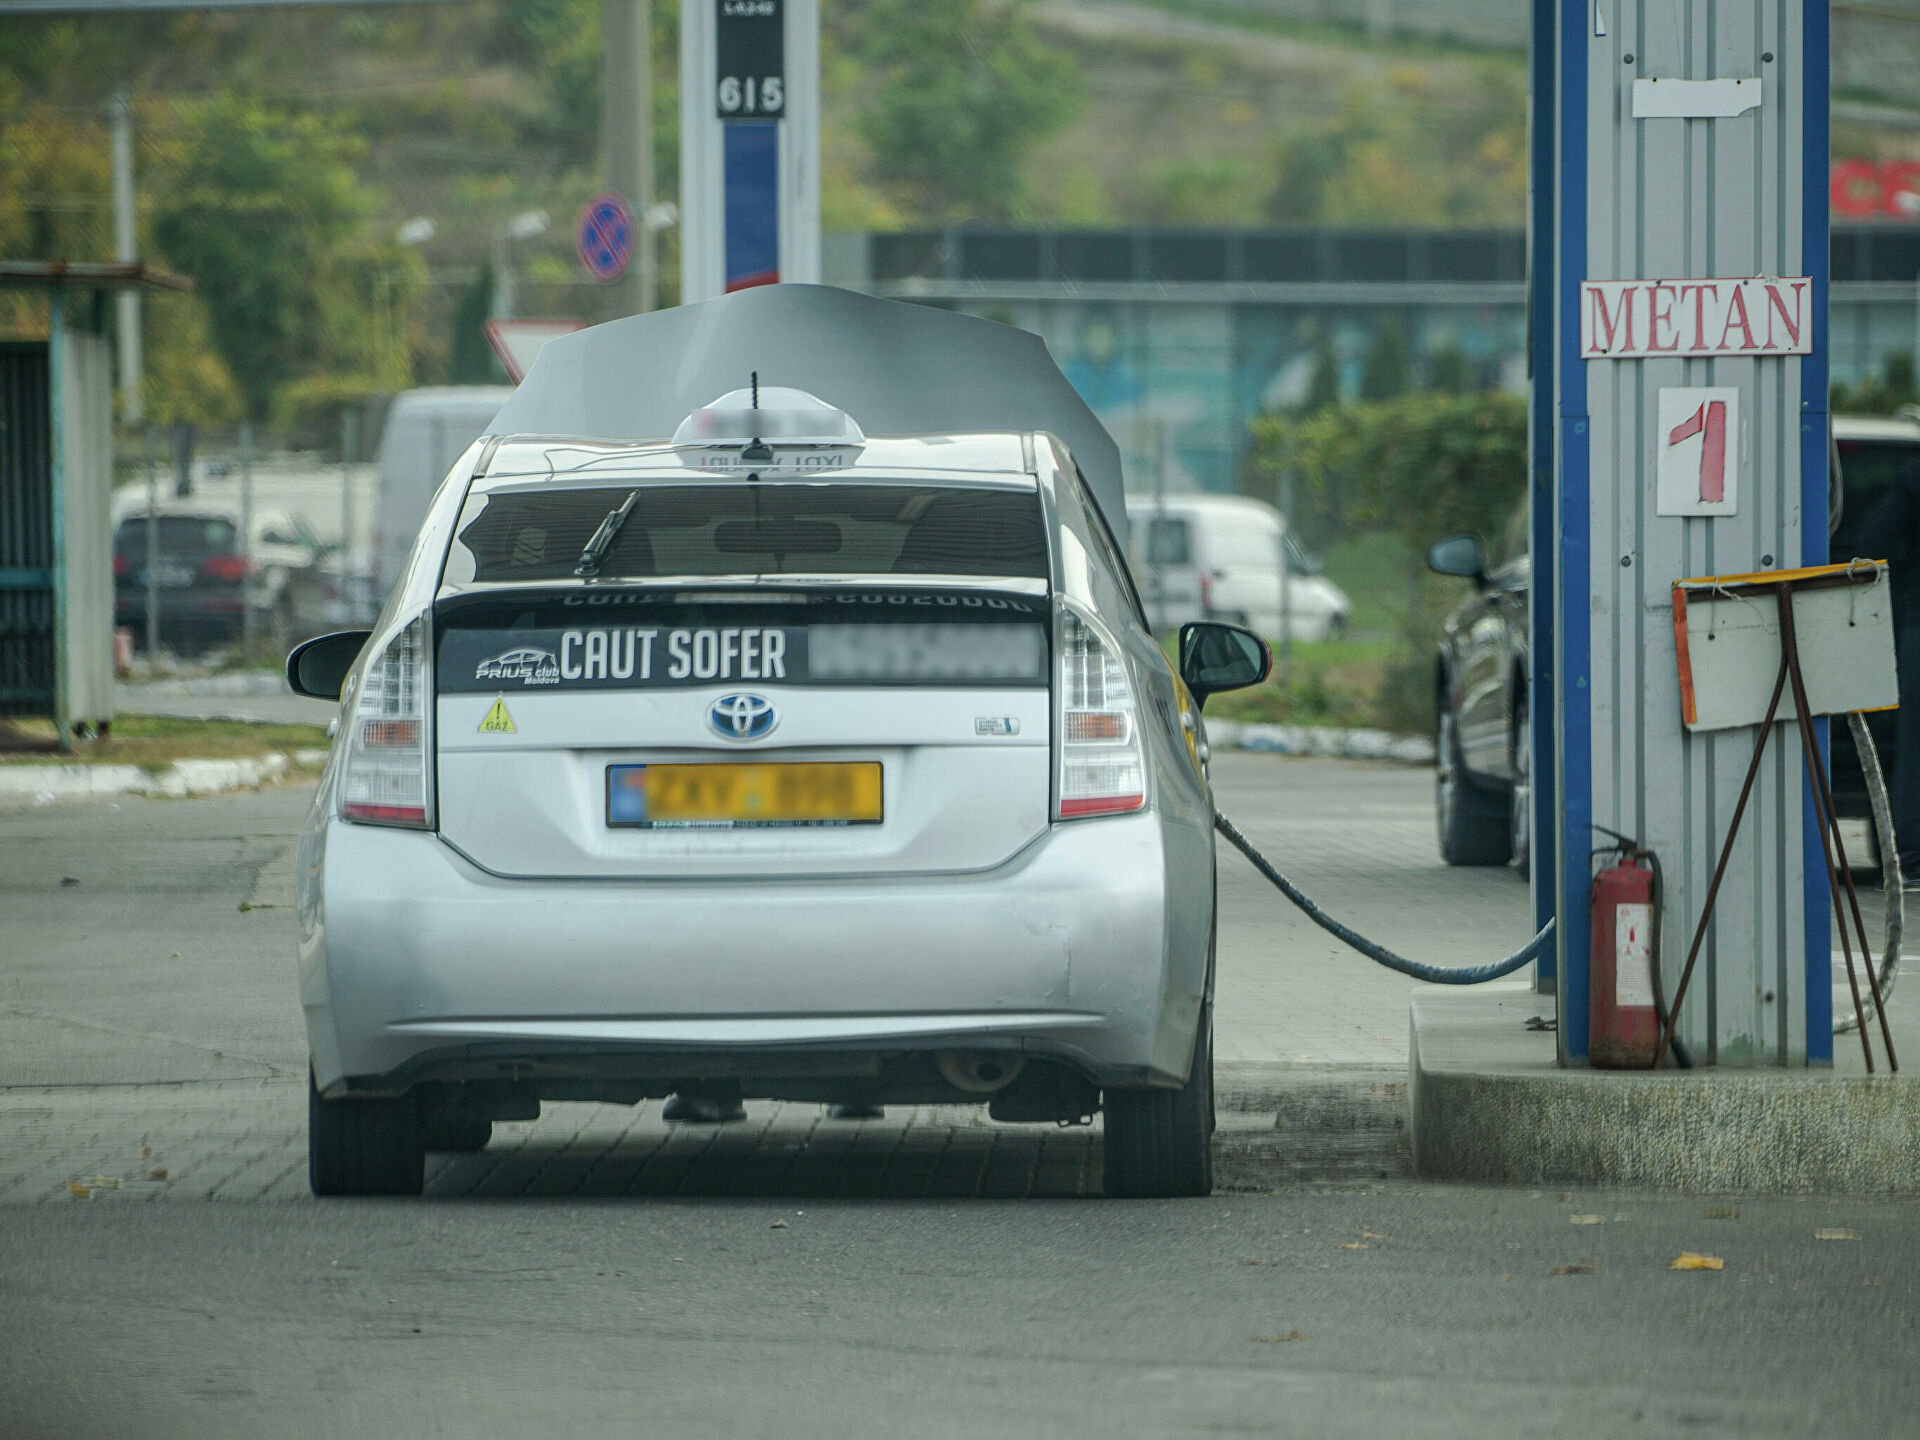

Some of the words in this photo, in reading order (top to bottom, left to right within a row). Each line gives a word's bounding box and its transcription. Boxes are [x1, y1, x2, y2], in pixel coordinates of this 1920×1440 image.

[719, 76, 784, 113] 615
[1586, 282, 1807, 353] METAN
[1667, 398, 1726, 504] 1
[475, 665, 534, 679] PRIUS
[534, 666, 560, 678] club
[560, 629, 659, 680] CAUT
[667, 628, 787, 680] SOFER
[524, 676, 560, 685] Moldova
[486, 721, 508, 732] GAZ
